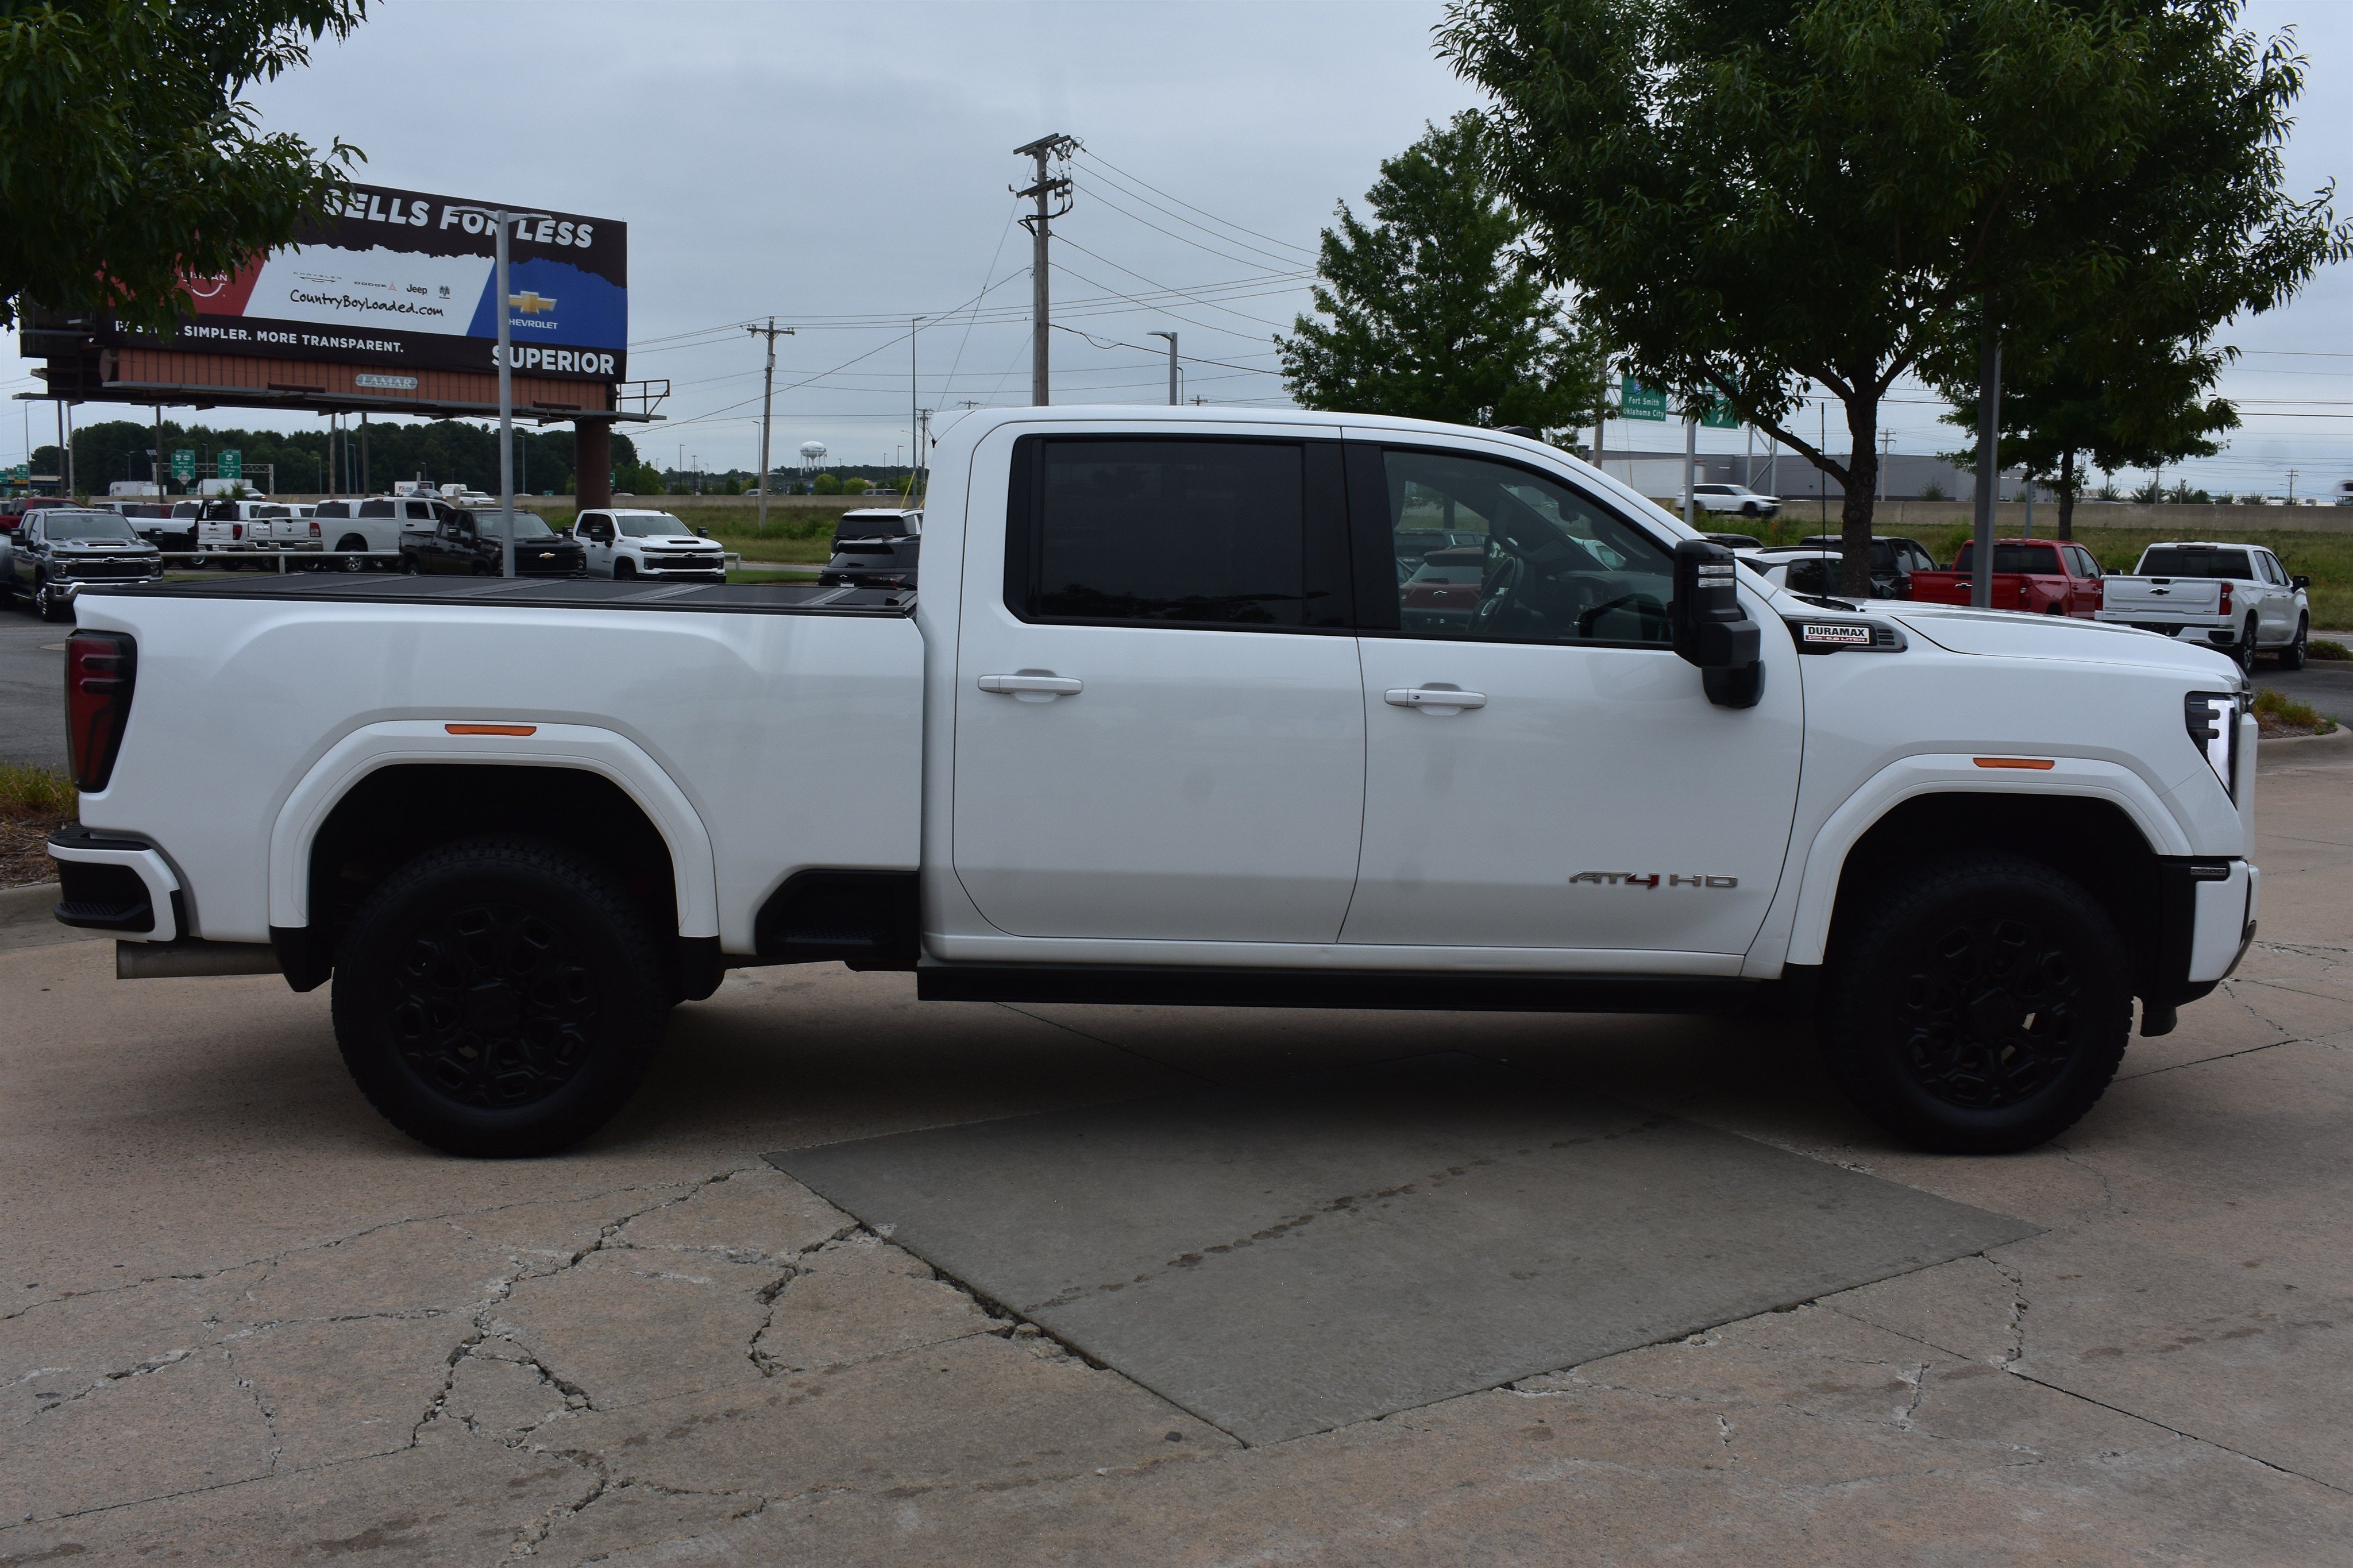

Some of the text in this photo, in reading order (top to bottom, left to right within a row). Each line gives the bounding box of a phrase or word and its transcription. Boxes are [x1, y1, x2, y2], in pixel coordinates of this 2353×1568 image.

[323, 188, 430, 227] SELLS
[516, 219, 593, 248] LESS
[181, 272, 227, 281] ISAN
[294, 272, 342, 280] CHRYSLER
[406, 284, 427, 295] Jeep
[290, 289, 443, 316] CountryBoyLoaded.com
[509, 318, 558, 329] HEVROLET
[184, 325, 252, 341] SIMPLER.
[257, 330, 297, 344] MORE
[302, 334, 404, 353] TRANSPARENT.
[491, 345, 615, 375] SUPERIOR
[362, 376, 412, 388] LAMAR
[1629, 396, 1660, 406] Fort Smith
[1623, 408, 1664, 419] Oklahoma City
[1808, 627, 1865, 636] DURAMAX
[1569, 871, 1738, 889] AT4 HD
